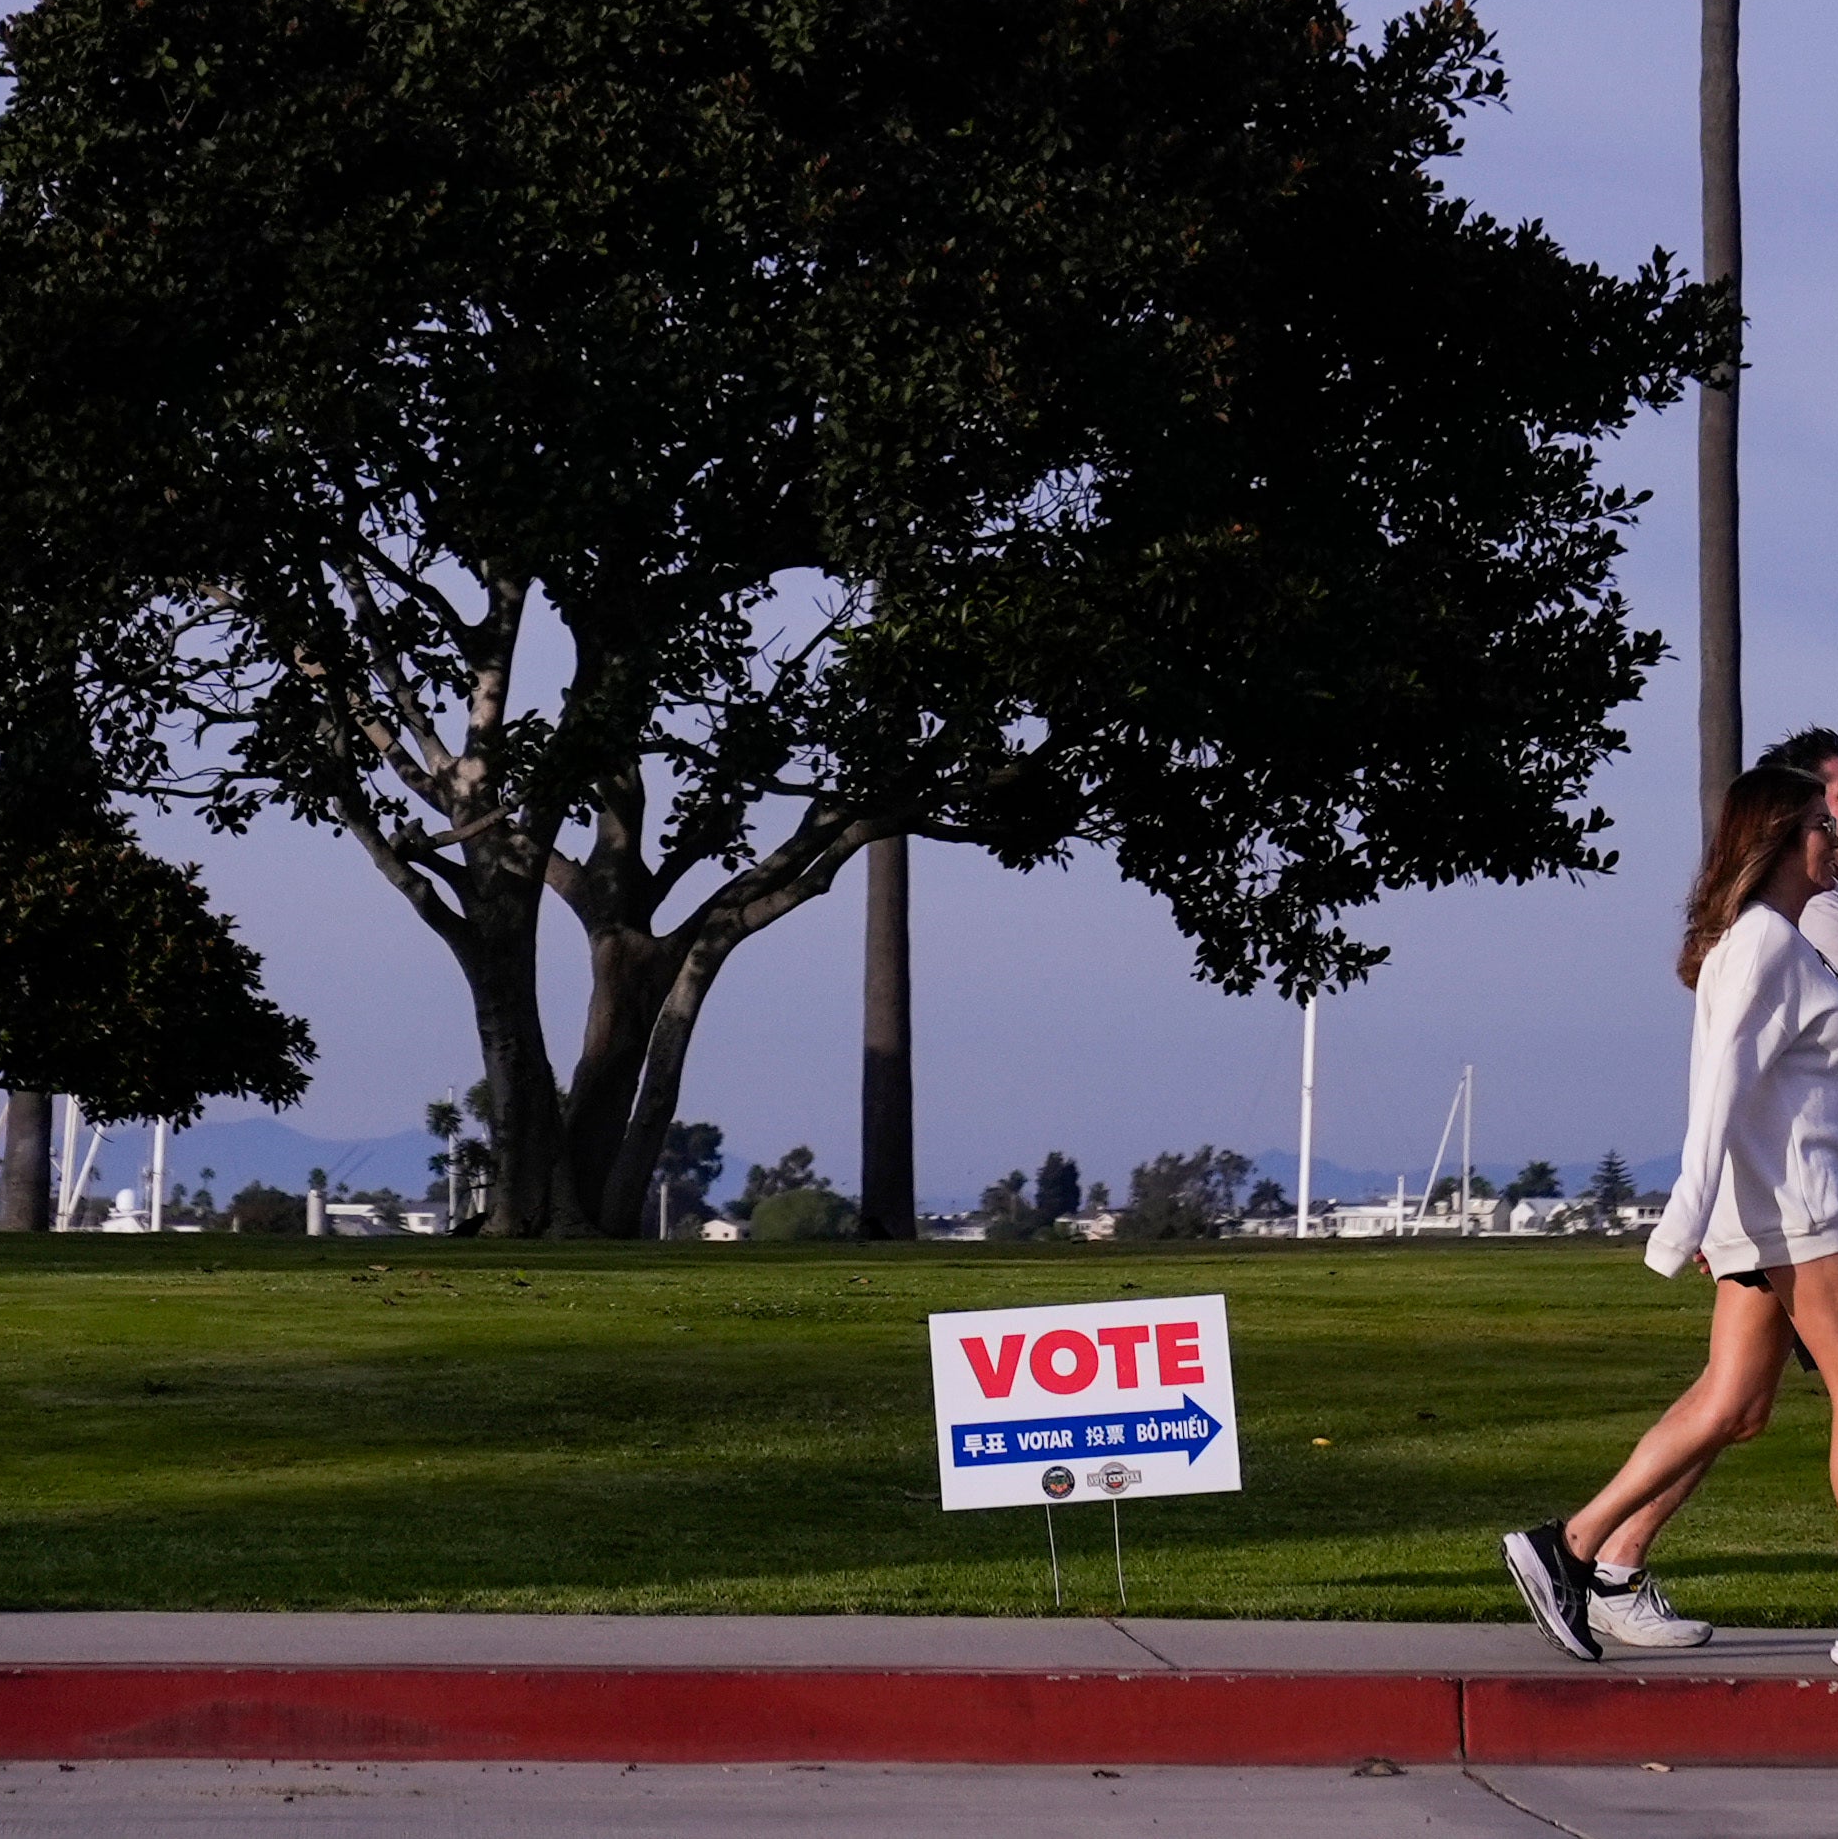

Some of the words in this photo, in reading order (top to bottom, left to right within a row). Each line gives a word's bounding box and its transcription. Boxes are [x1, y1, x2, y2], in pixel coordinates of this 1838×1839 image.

[960, 1321, 1206, 1399] VOTE
[1017, 1429, 1074, 1450] VOTAR
[1085, 1424, 1126, 1447] 投票
[1136, 1417, 1159, 1442] BỎ
[1161, 1413, 1209, 1441] PHIẾU
[962, 1432, 1008, 1458] 투표
